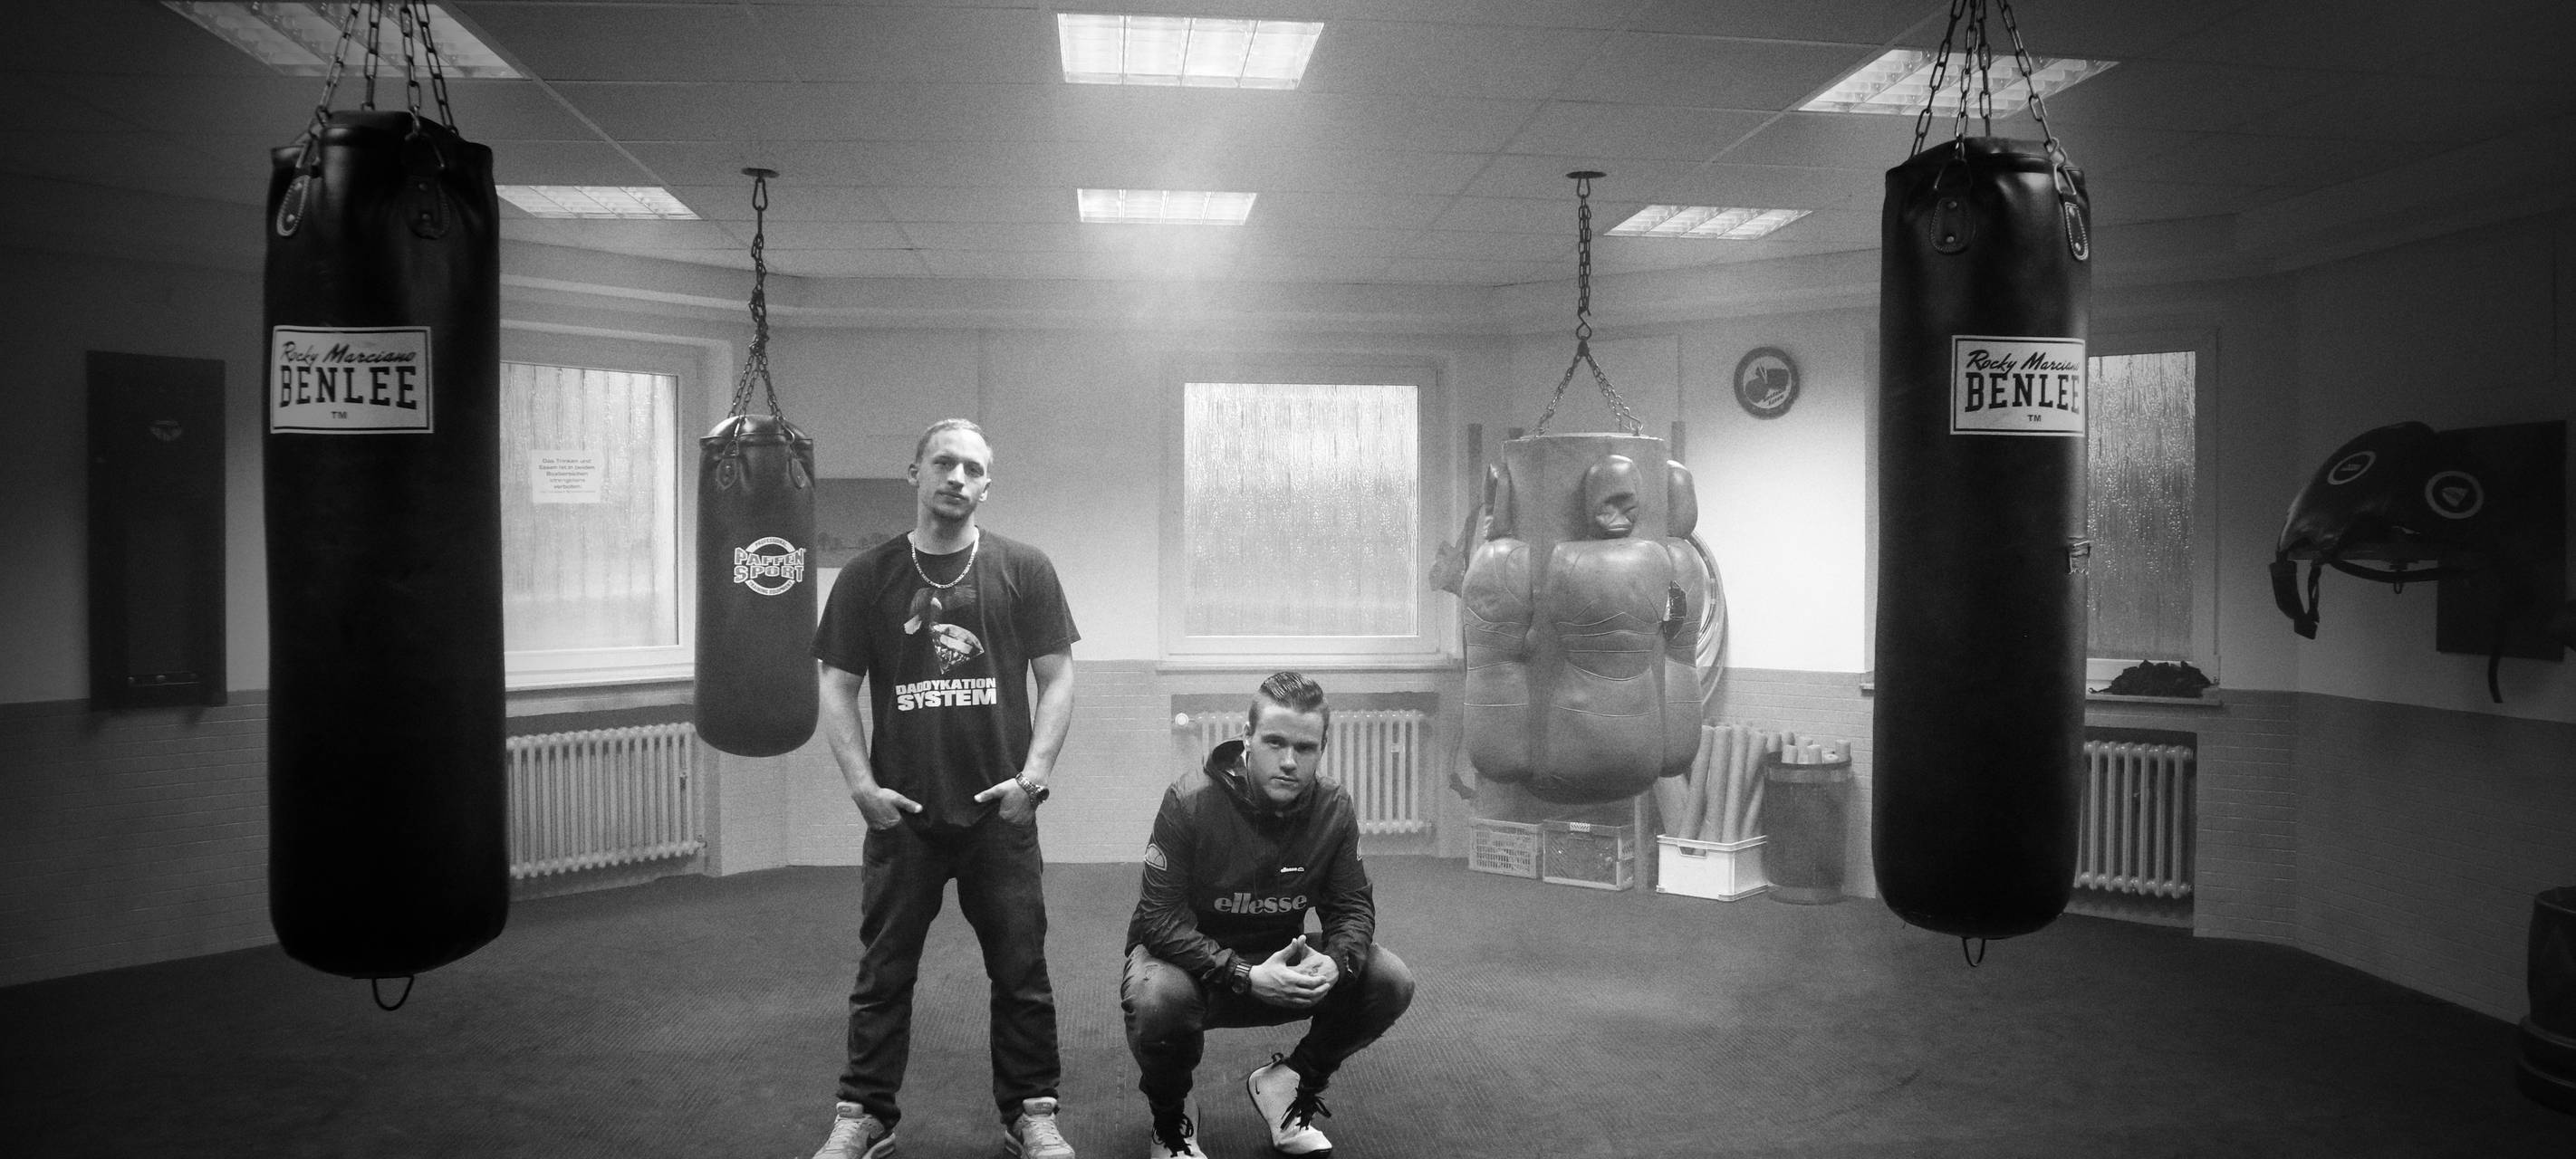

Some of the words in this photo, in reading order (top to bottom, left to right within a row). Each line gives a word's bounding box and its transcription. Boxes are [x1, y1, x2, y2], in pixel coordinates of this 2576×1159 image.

[280, 340, 319, 367] Rocky
[322, 343, 417, 363] Marciano
[1966, 350, 2017, 374] Rocky
[279, 365, 417, 409] BENLEE
[1965, 372, 2080, 415] BENLEE
[734, 547, 804, 566] PAFFEN
[734, 565, 804, 583] SPORT
[896, 677, 996, 695] DADDYKATION
[897, 688, 997, 711] SYSTEM
[1214, 892, 1307, 915] ellesse
